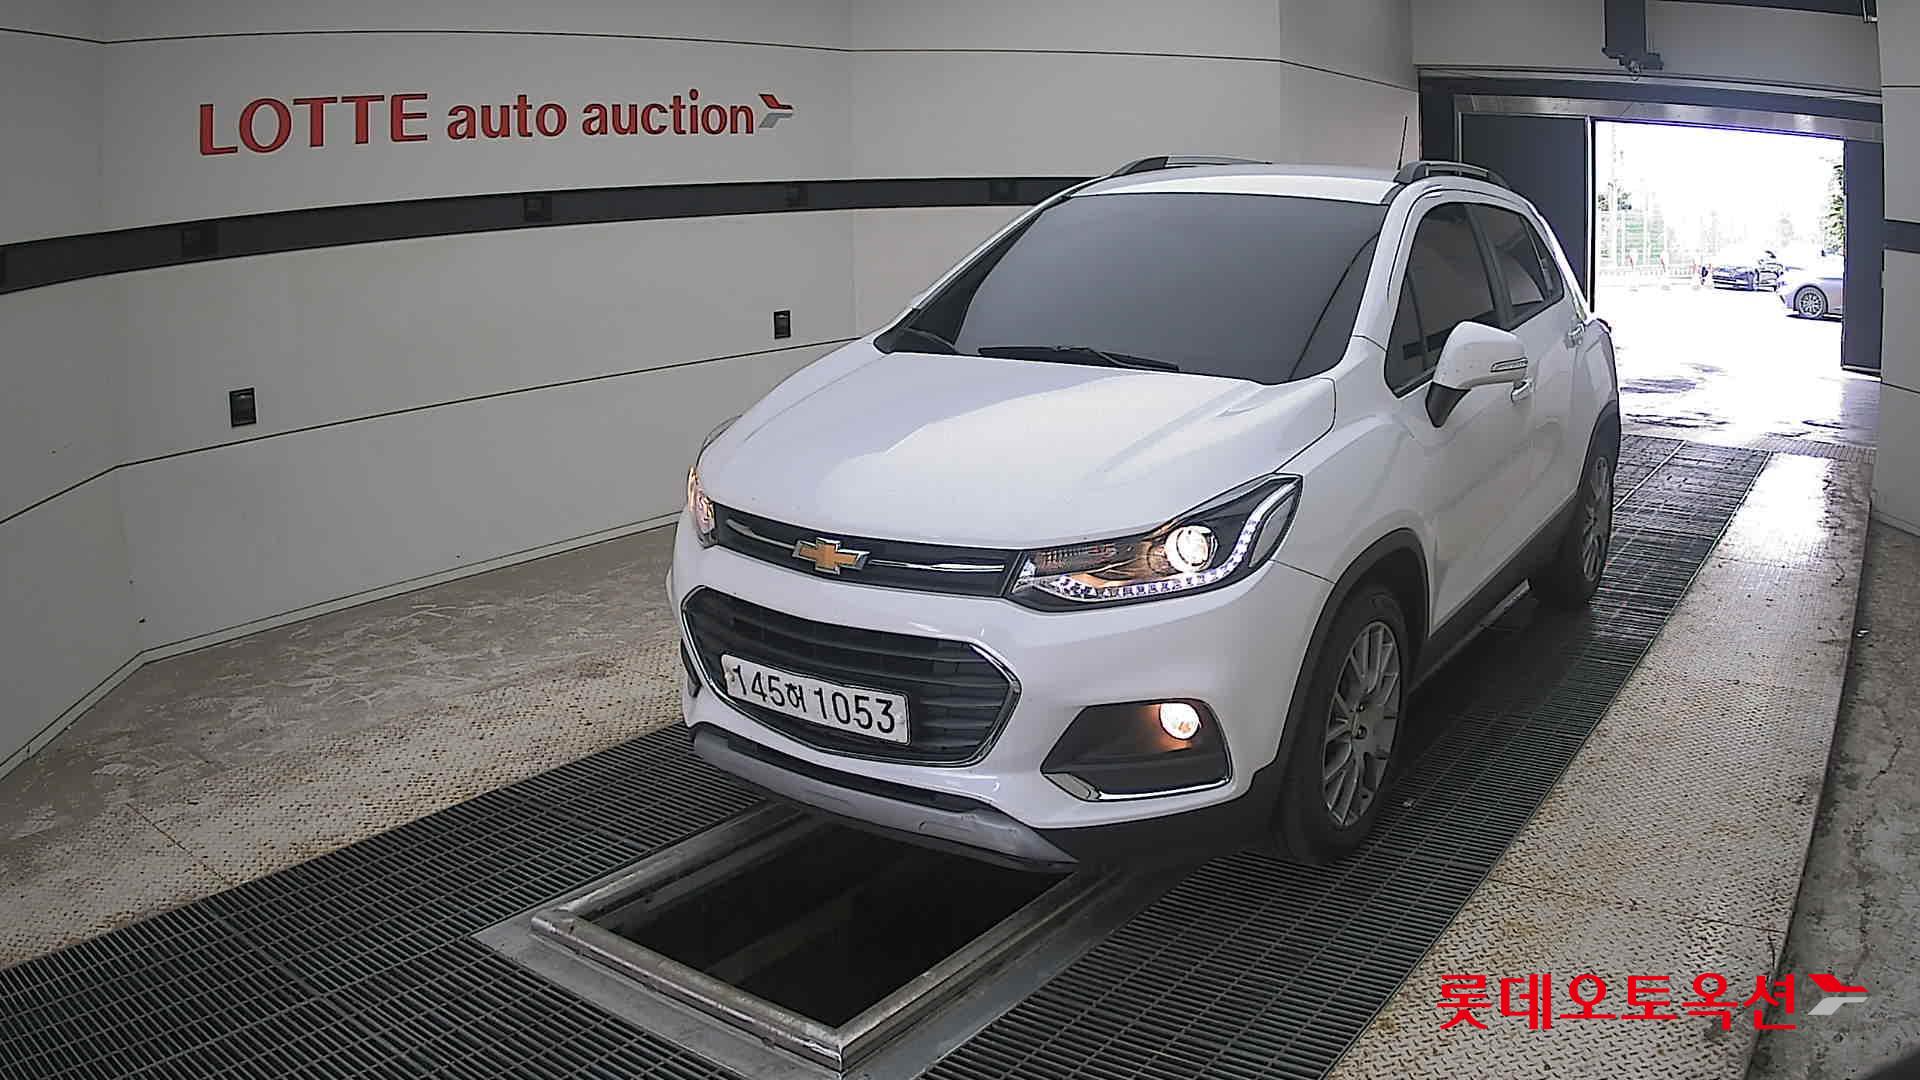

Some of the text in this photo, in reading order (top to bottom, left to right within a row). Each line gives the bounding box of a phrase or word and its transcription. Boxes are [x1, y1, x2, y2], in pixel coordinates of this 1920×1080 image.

[199, 88, 755, 155] LOTTE auto auction
[814, 686, 896, 735] 1053
